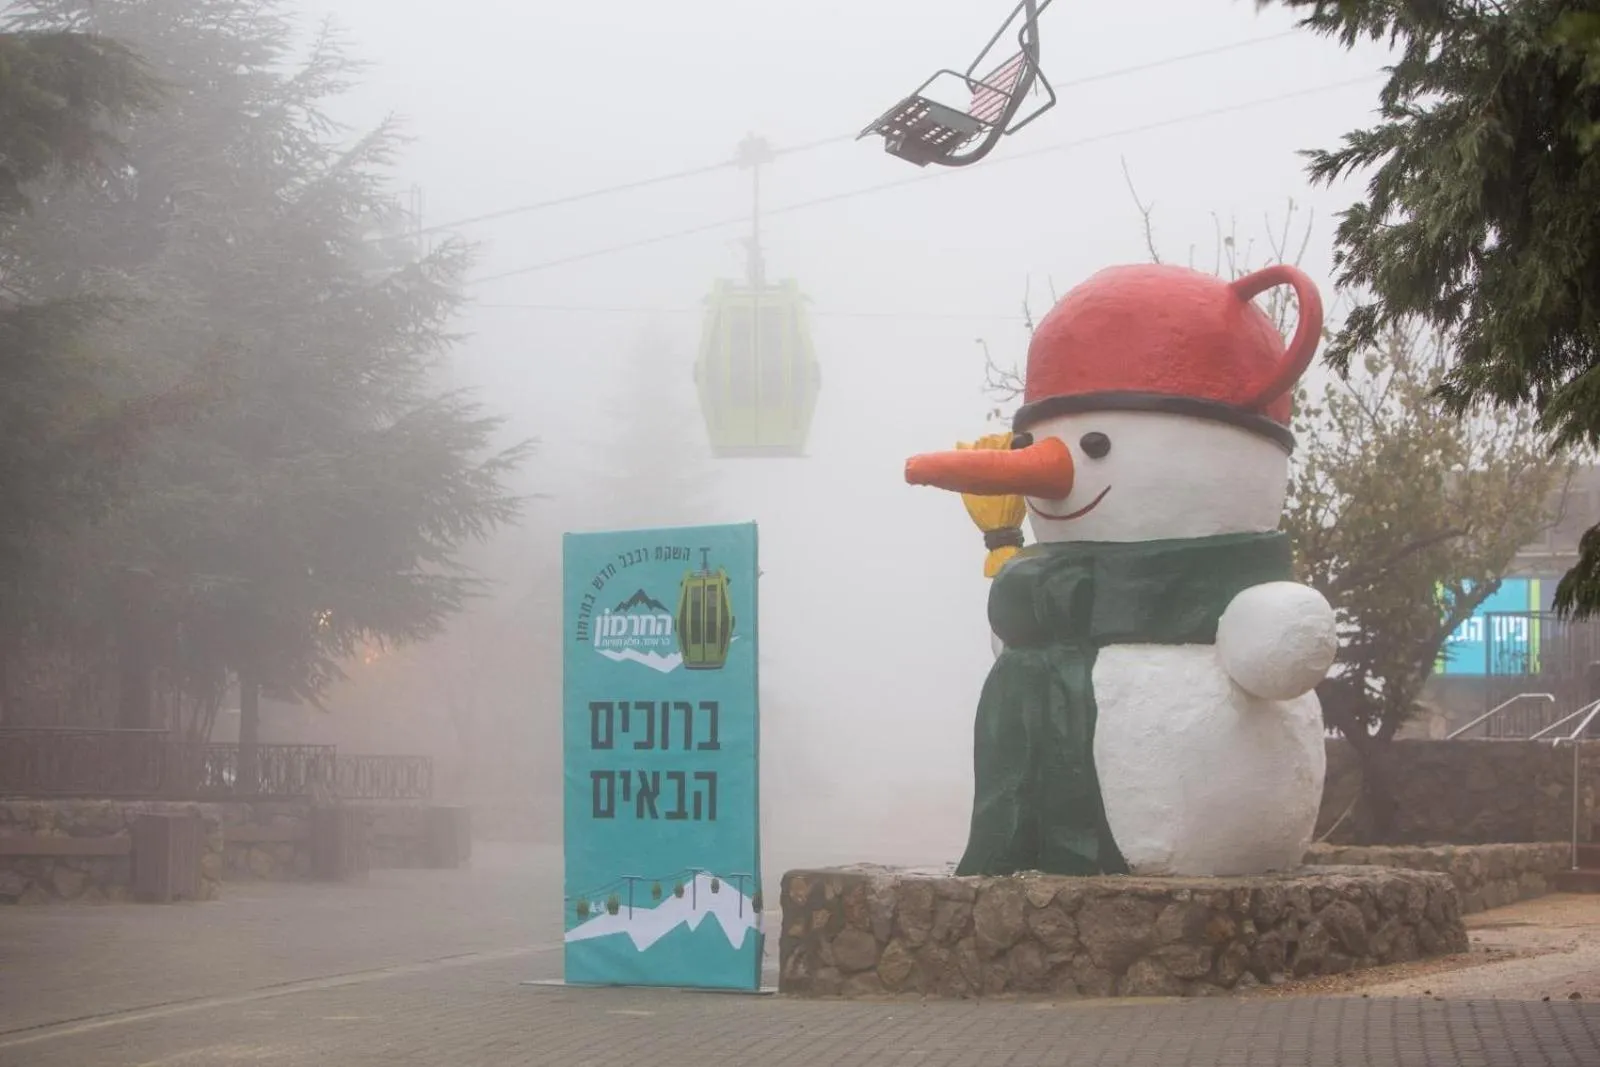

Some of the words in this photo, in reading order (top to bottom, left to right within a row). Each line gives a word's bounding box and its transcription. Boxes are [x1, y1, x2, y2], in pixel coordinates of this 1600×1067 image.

[618, 548, 649, 568] רכבל
[655, 546, 691, 562] השקת
[592, 563, 617, 591] חדש
[576, 593, 597, 642] בחרמון
[594, 608, 673, 647] החרמון
[588, 701, 721, 750] ברוכים
[590, 770, 718, 821] הבאים
